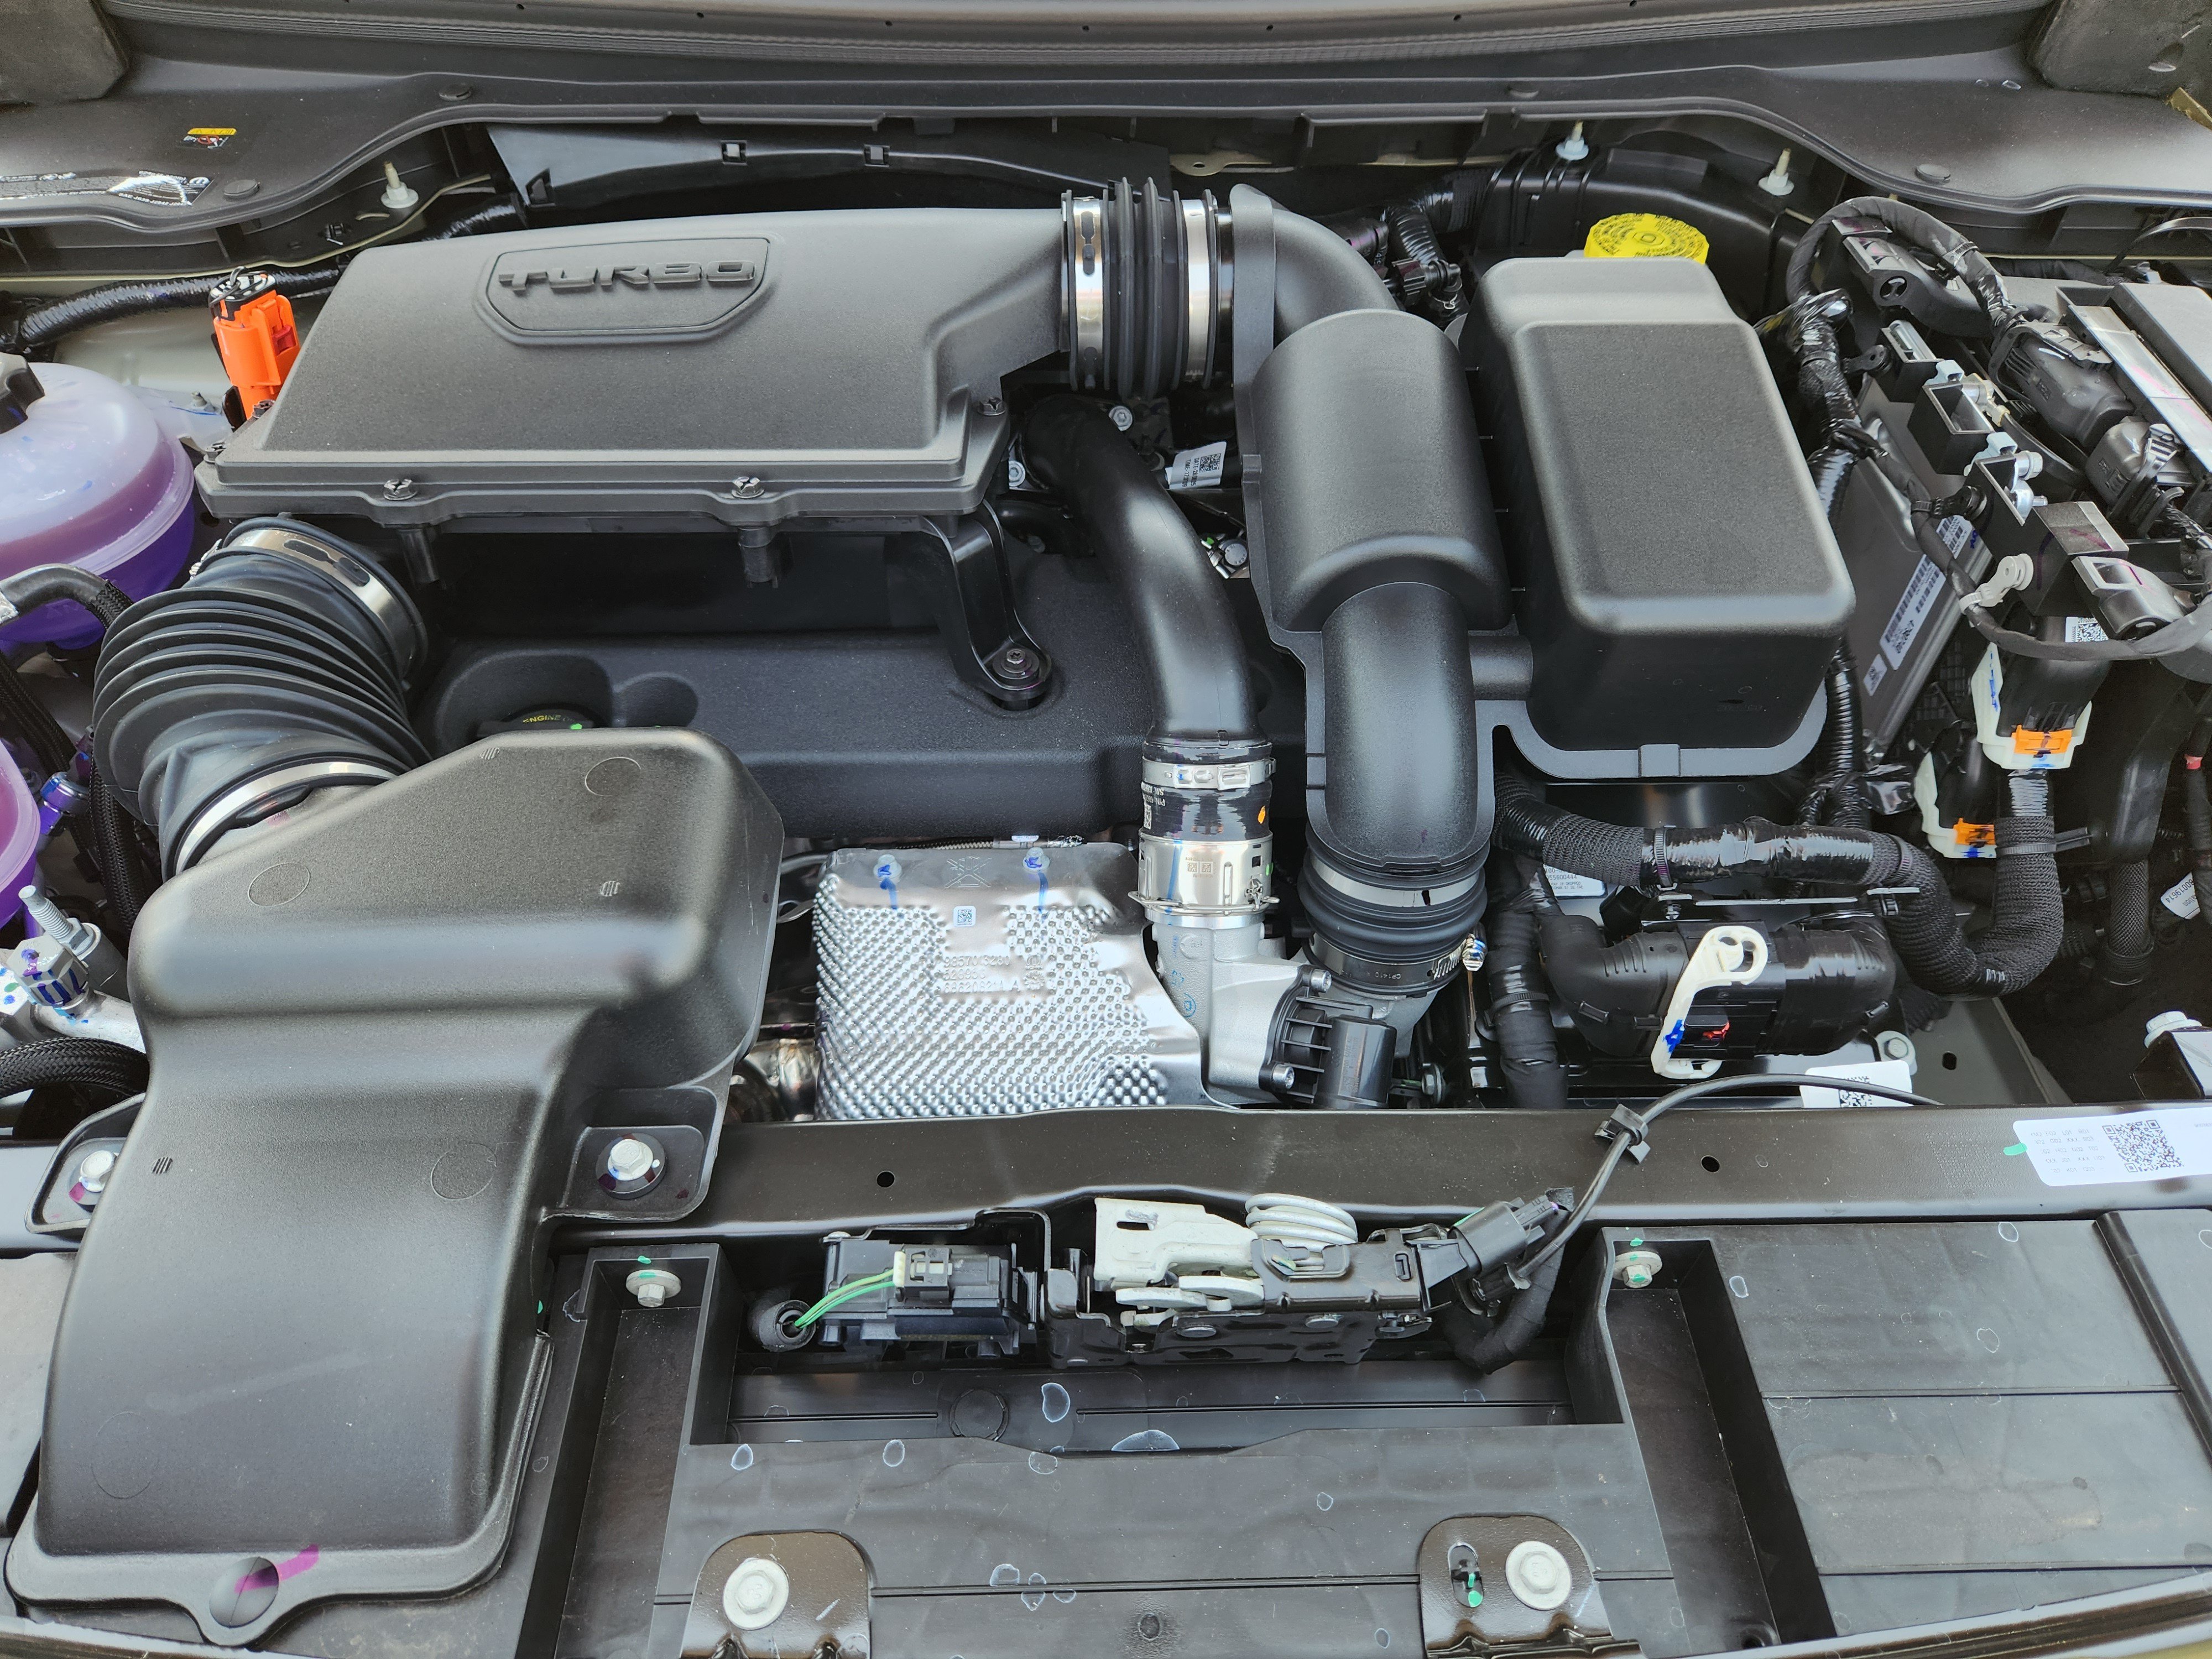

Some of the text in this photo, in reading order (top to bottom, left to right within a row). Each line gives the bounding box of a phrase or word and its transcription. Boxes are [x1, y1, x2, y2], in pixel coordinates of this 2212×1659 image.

[498, 260, 757, 292] TURBO
[522, 714, 561, 723] ENGINE
[2182, 895, 2198, 906] ation
